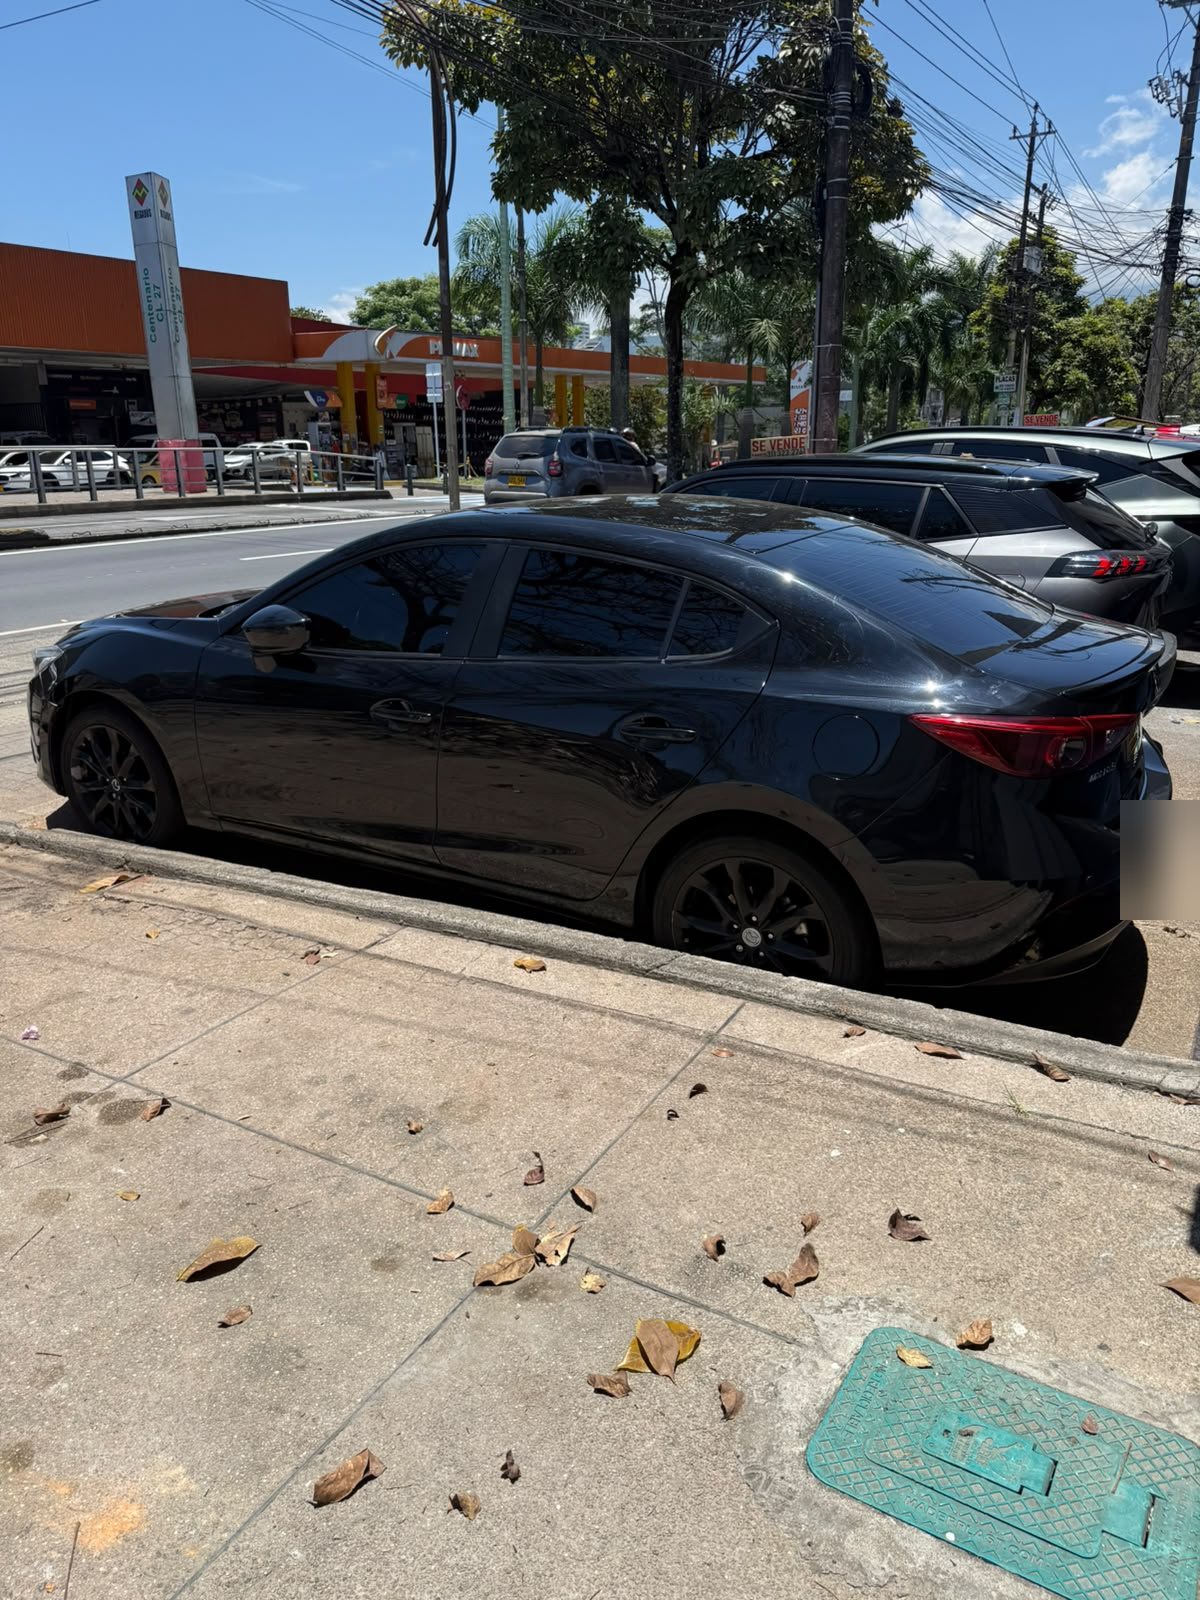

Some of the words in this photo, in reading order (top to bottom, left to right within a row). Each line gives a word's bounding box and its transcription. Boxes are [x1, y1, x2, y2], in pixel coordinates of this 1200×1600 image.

[153, 285, 162, 300] 27
[142, 267, 158, 343] Centenario
[155, 304, 164, 322] CL
[167, 267, 181, 344] Centenario
[1035, 414, 1059, 423] VENDE
[752, 440, 766, 452] SE
[769, 437, 805, 451] VENDE
